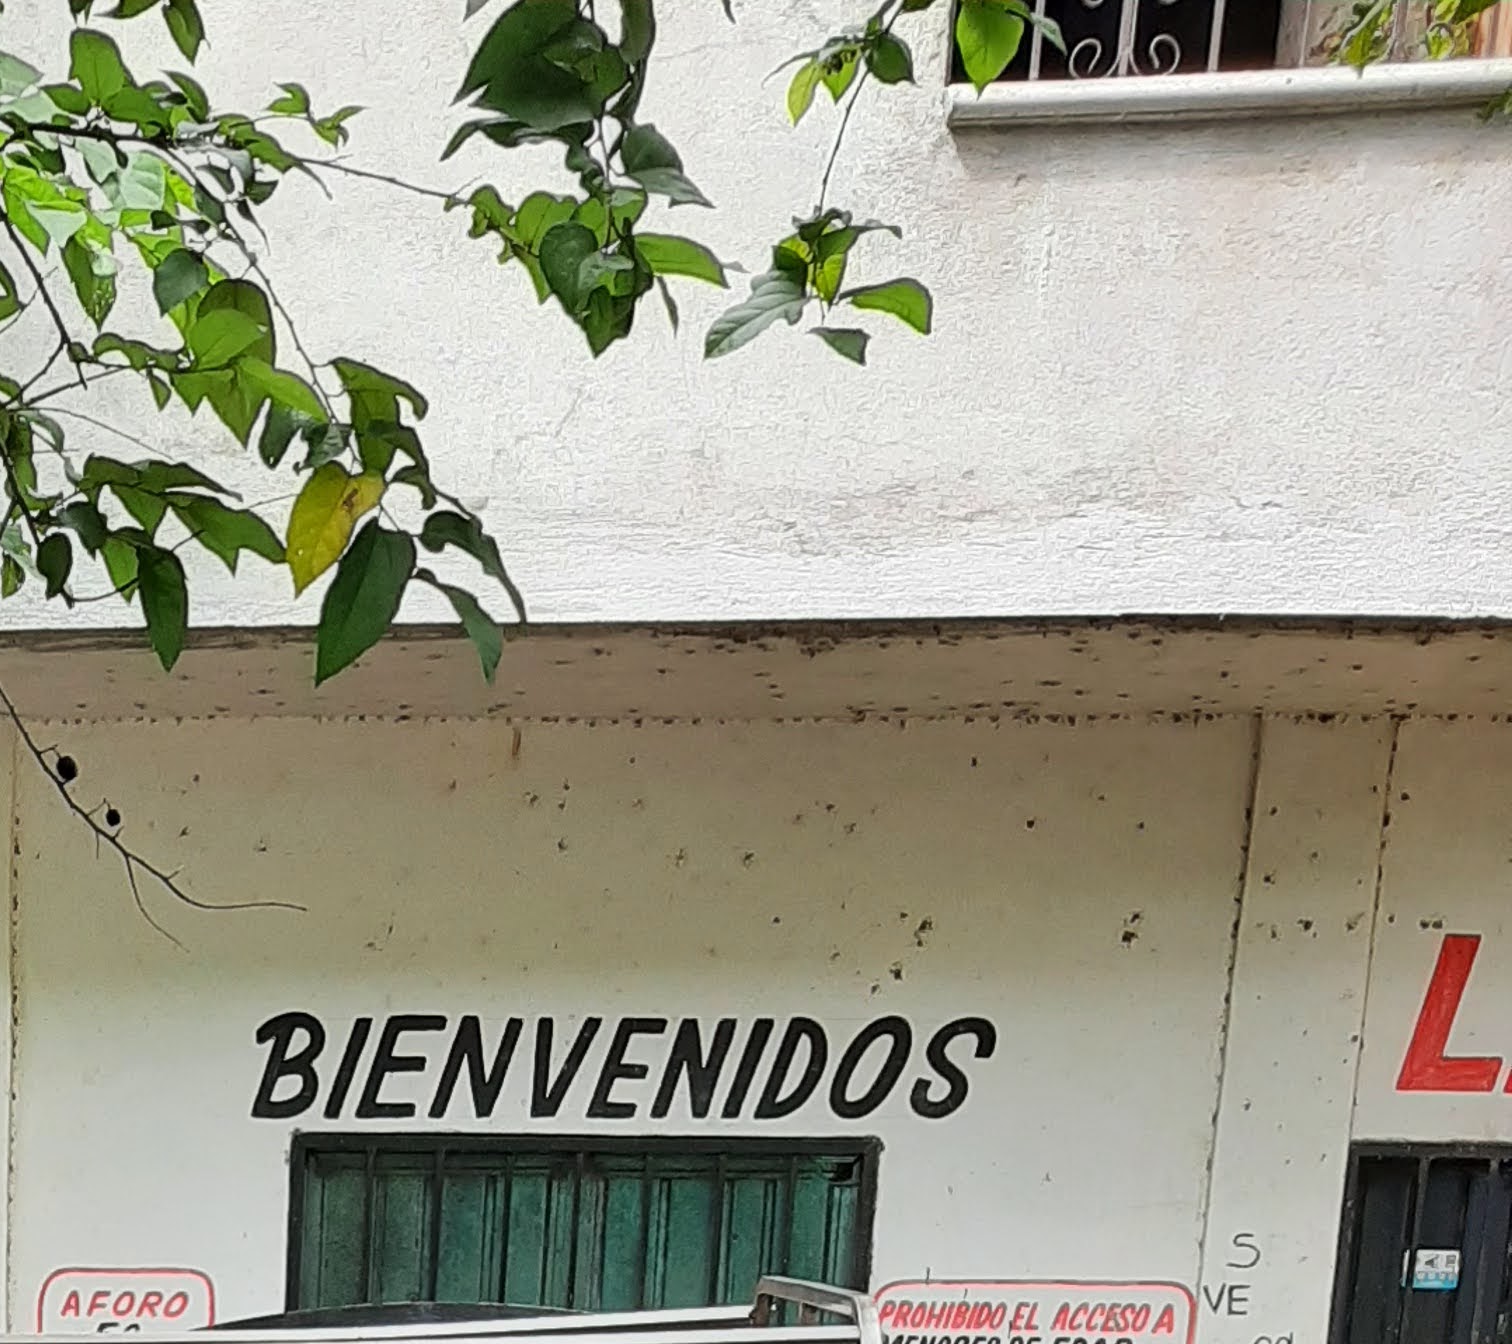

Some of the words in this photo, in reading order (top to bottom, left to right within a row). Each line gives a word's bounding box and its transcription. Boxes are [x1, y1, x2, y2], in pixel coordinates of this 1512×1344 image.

[1396, 933, 1512, 1093] L
[251, 1012, 996, 1119] BIENVENIDOS
[60, 1290, 189, 1318] AFORO
[879, 1301, 1007, 1331] PROHIBIDO
[1011, 1302, 1038, 1331] EL
[1050, 1302, 1151, 1333] ACCESO
[1151, 1303, 1174, 1334] A
